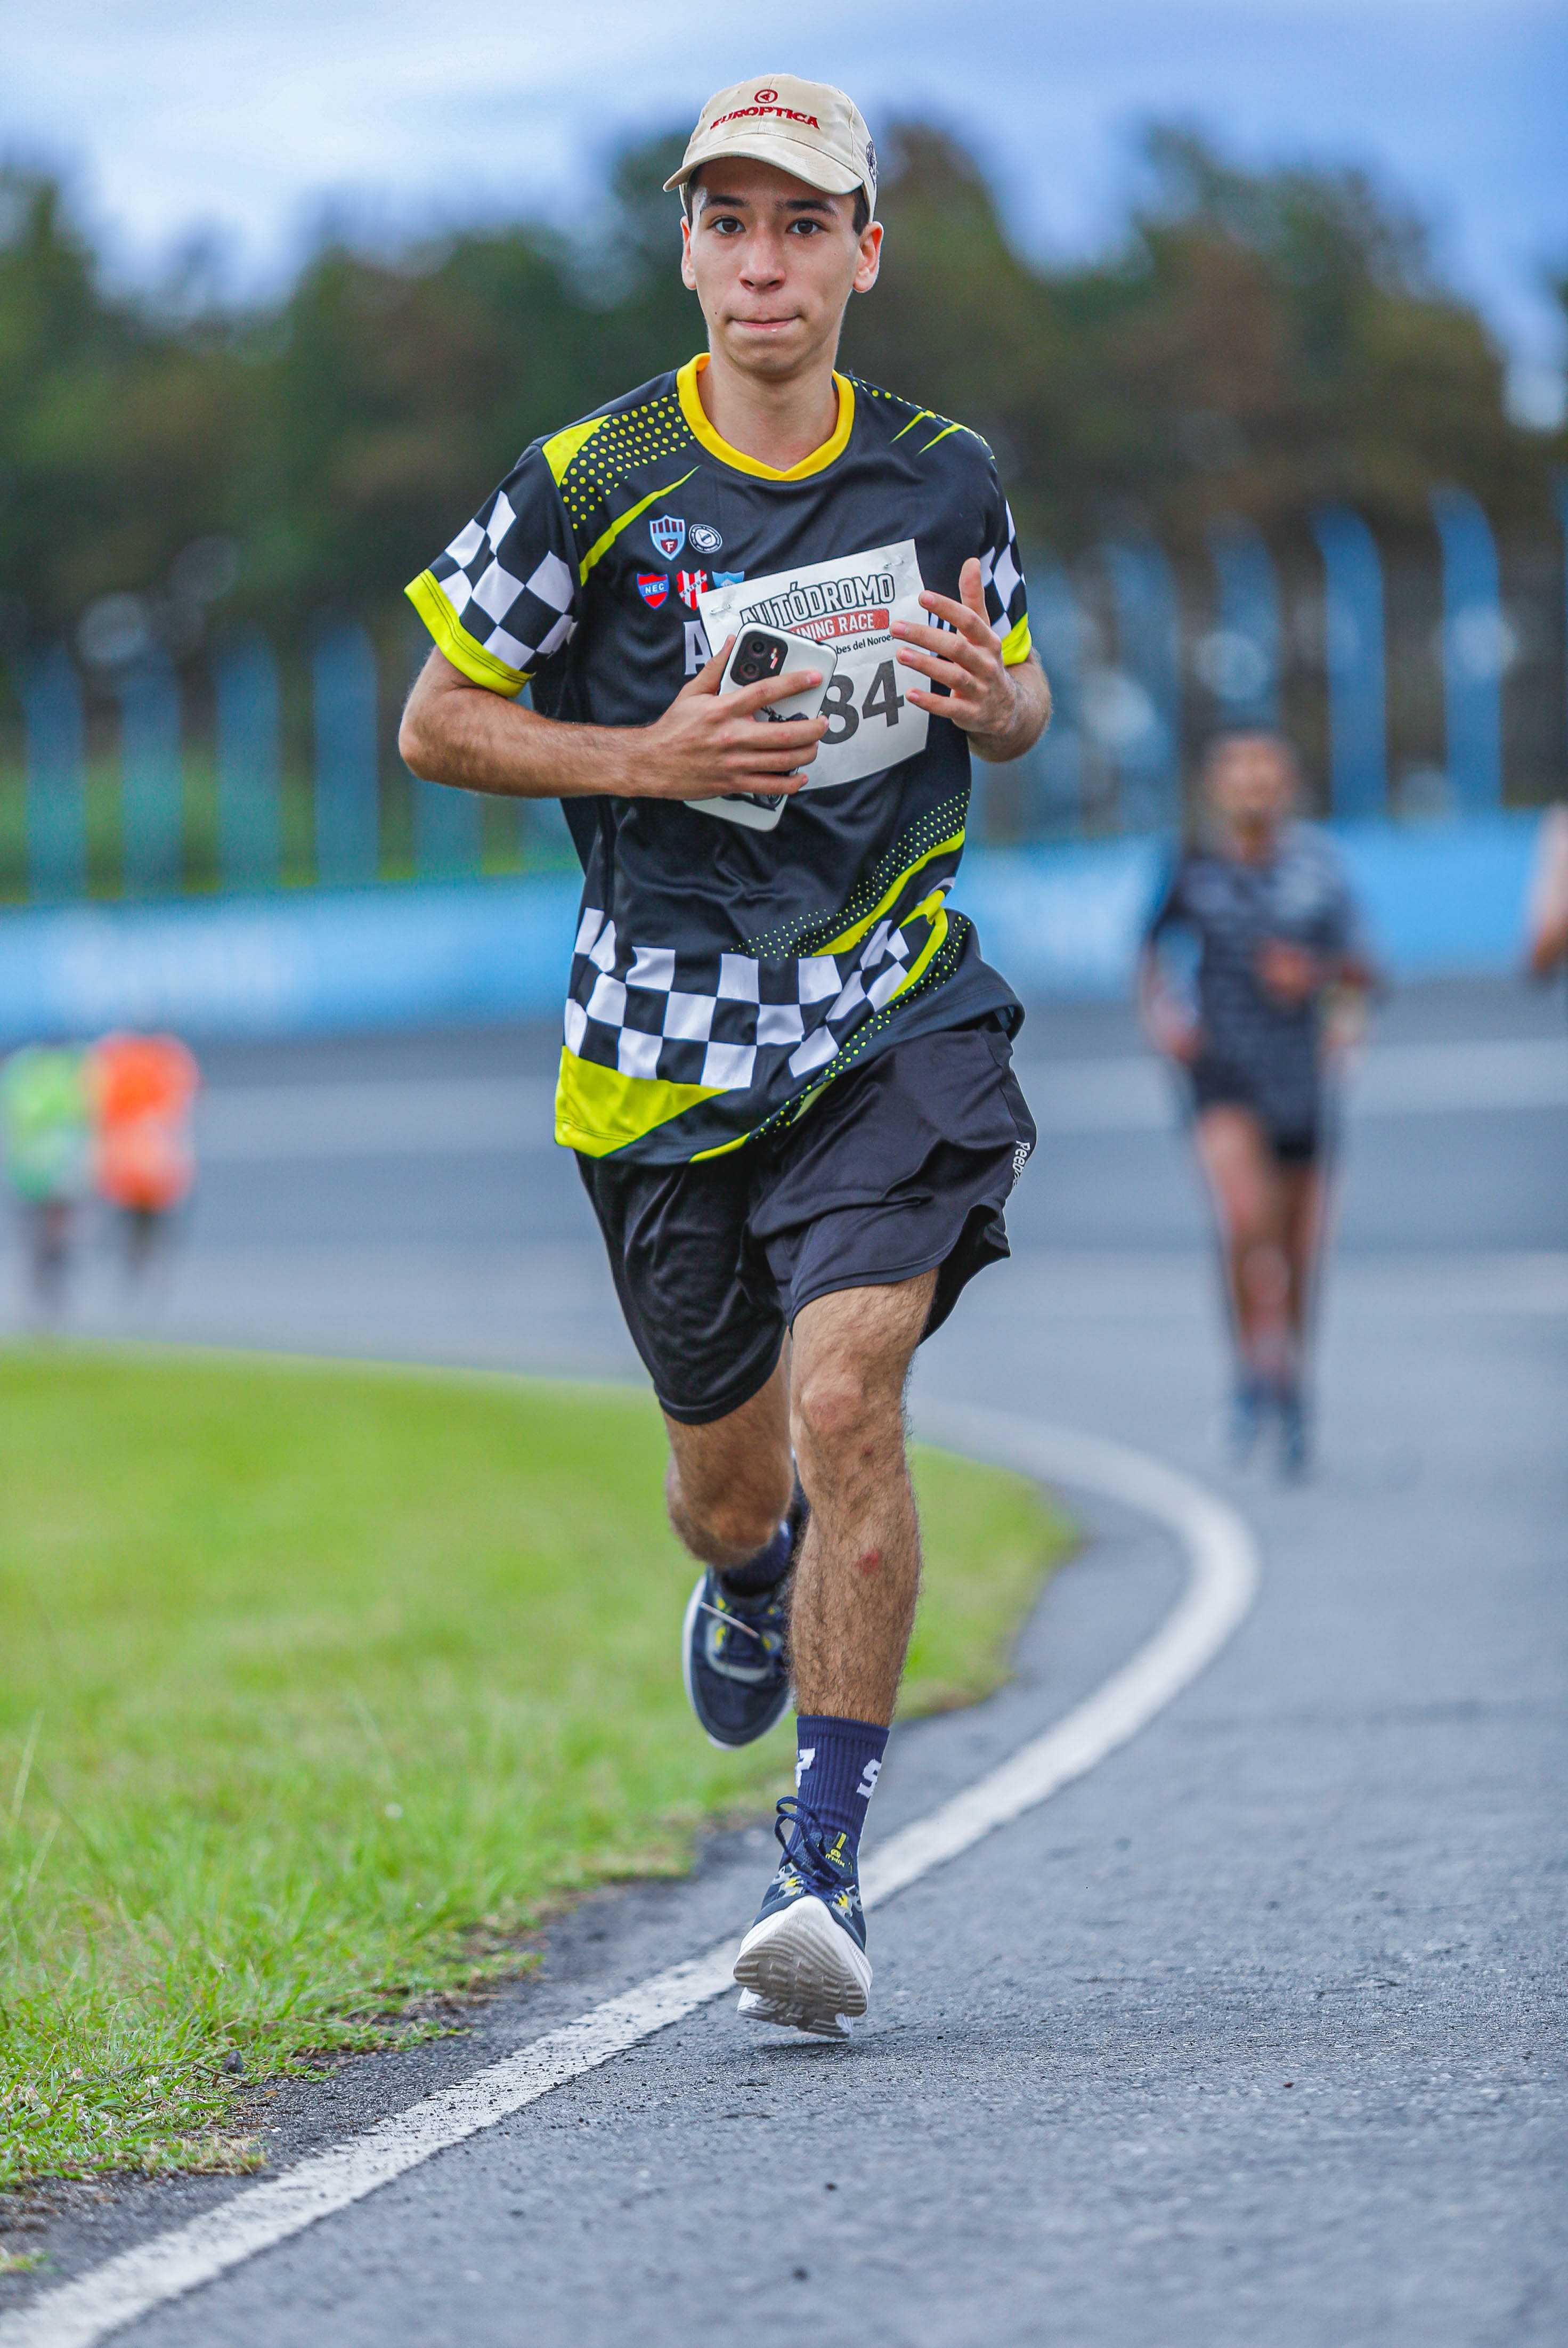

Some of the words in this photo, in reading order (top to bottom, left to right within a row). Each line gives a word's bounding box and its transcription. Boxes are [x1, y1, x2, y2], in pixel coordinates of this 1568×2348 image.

[645, 583, 664, 594] NEC
[838, 613, 875, 632] RACE
[836, 645, 851, 655] bes
[853, 640, 866, 651] del
[867, 634, 895, 646] Noroe
